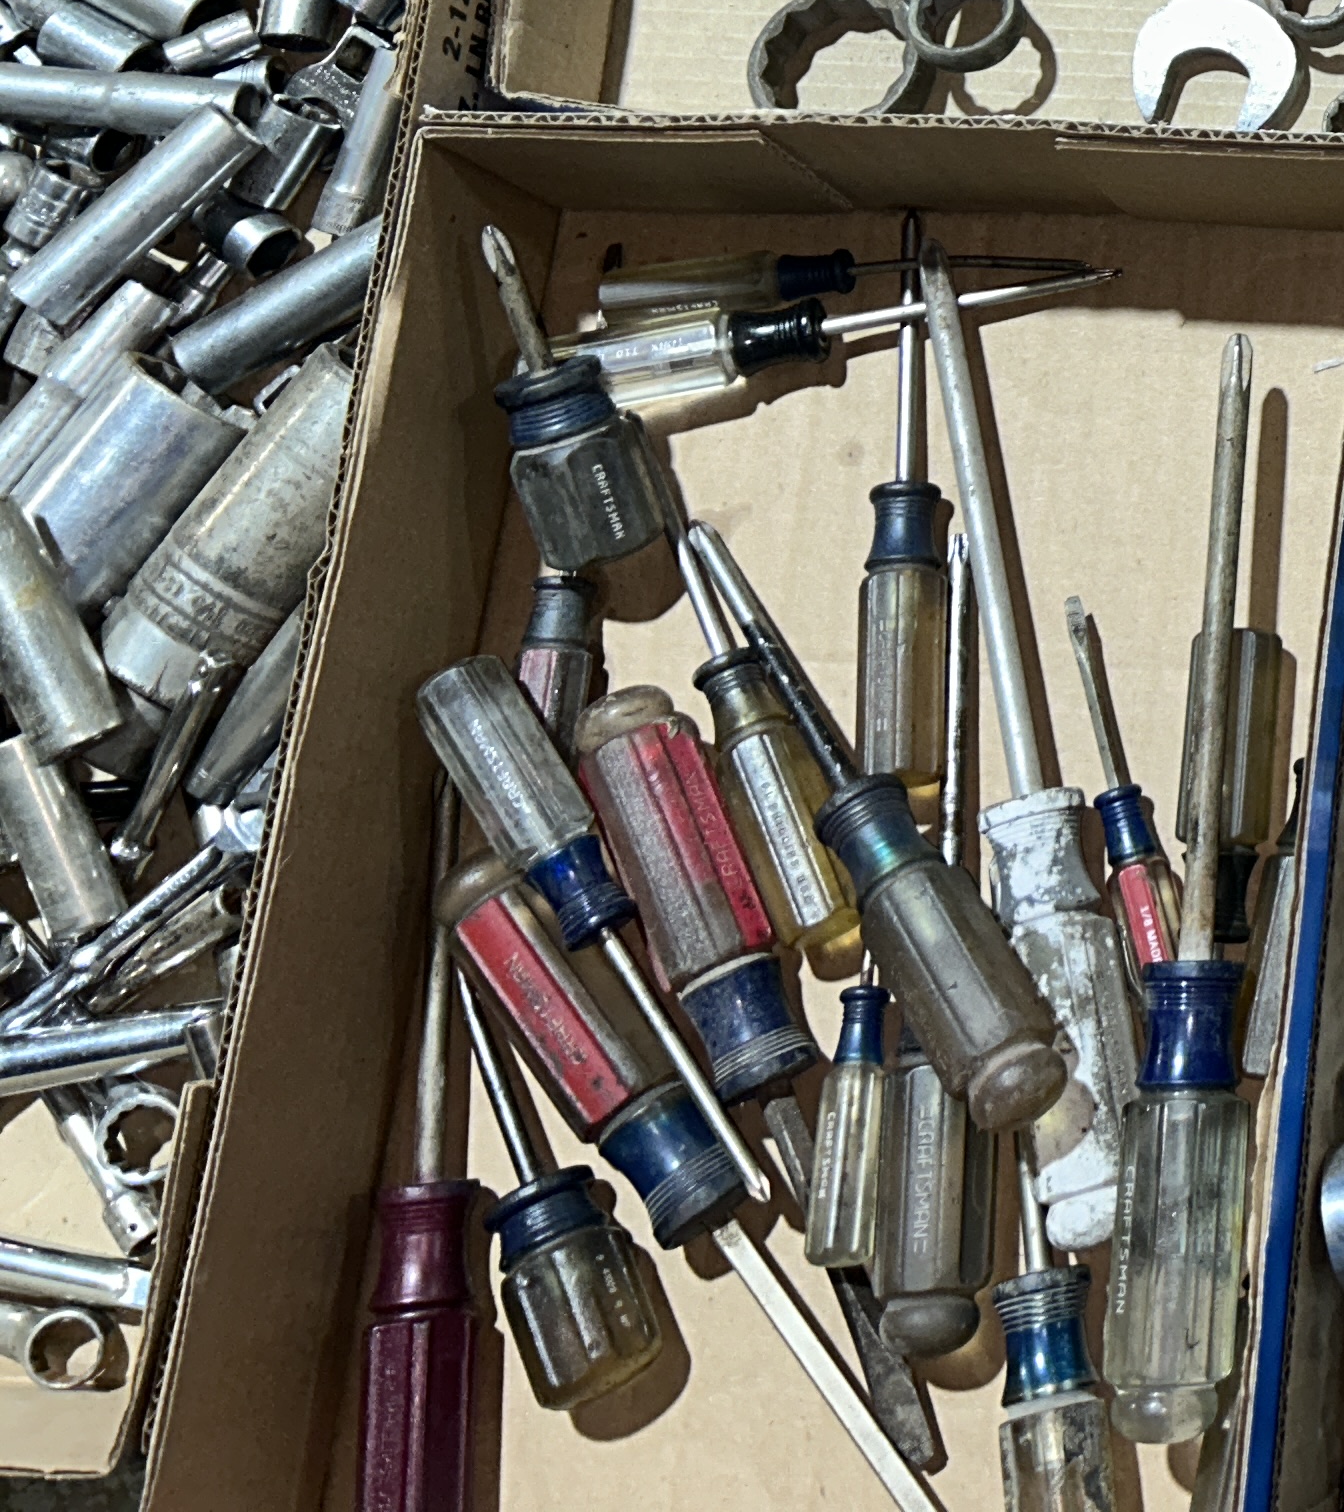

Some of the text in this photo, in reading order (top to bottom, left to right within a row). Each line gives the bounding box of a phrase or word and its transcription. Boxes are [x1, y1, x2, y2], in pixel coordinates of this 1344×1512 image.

[592, 463, 626, 541] CRAFTSMAN
[471, 719, 527, 809] CRAFTSMAN
[1140, 905, 1154, 928] 1/8
[913, 1118, 936, 1242] CRAFTSMAN
[1115, 1165, 1137, 1316] CRAFTSMAN
